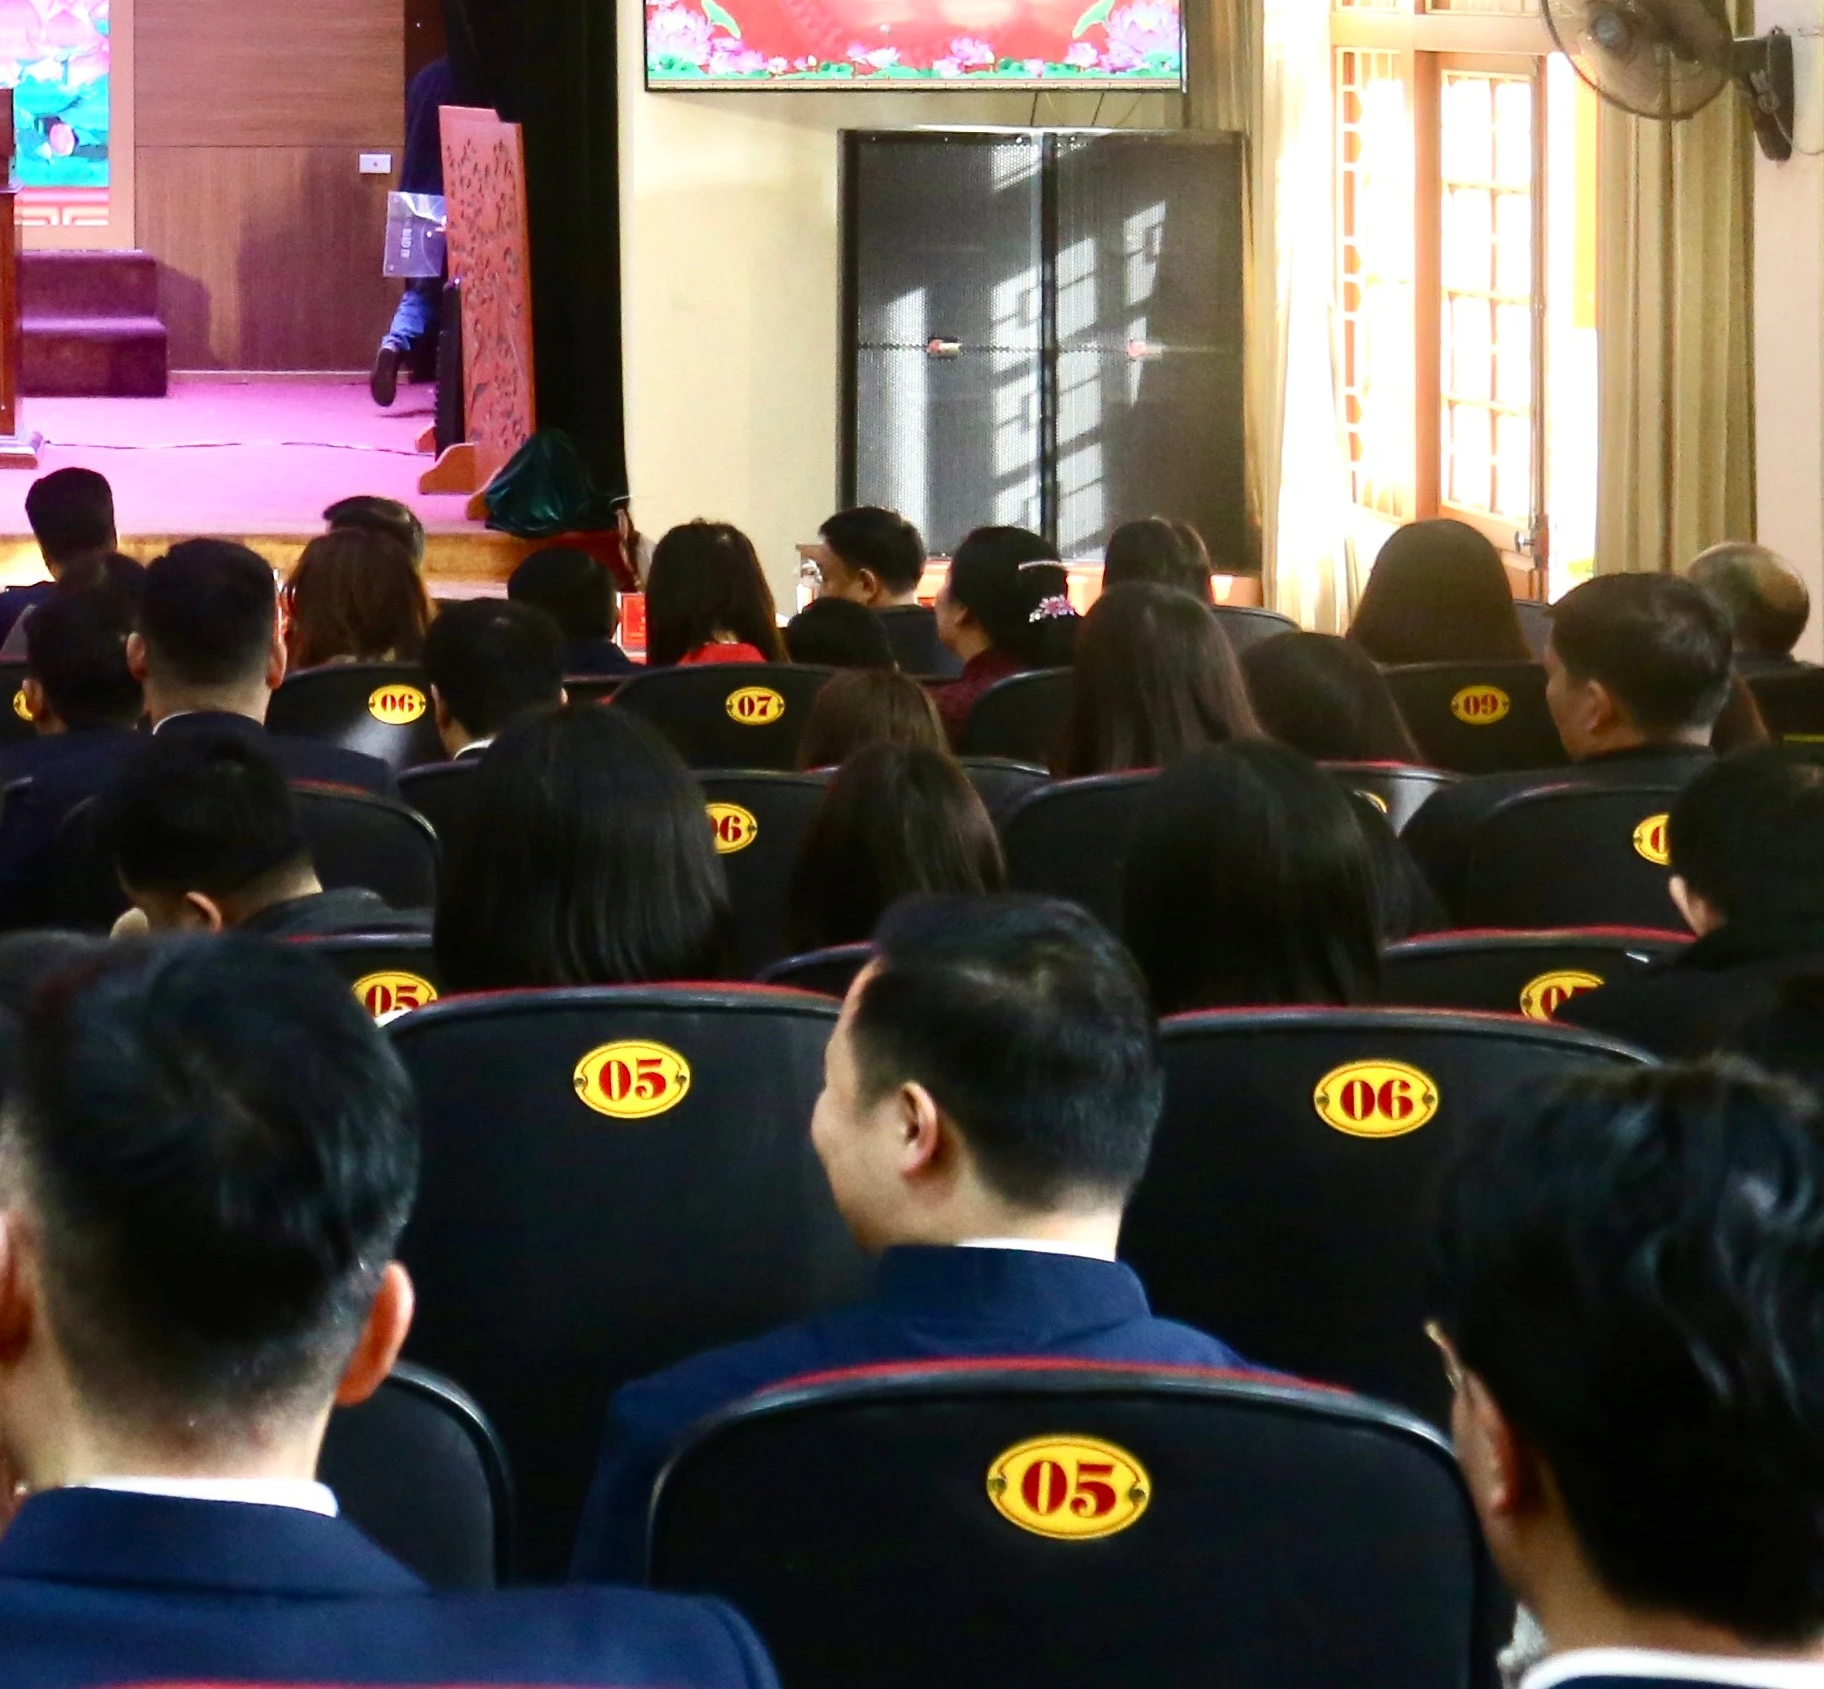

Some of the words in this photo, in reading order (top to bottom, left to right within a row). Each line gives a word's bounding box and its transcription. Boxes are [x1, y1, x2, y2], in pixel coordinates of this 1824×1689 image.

[380, 693, 415, 712] 06
[737, 696, 772, 717] 07
[1463, 694, 1499, 715] 09
[598, 1060, 668, 1100] 05
[1340, 1079, 1413, 1121] 06
[1020, 1459, 1118, 1518] 05
